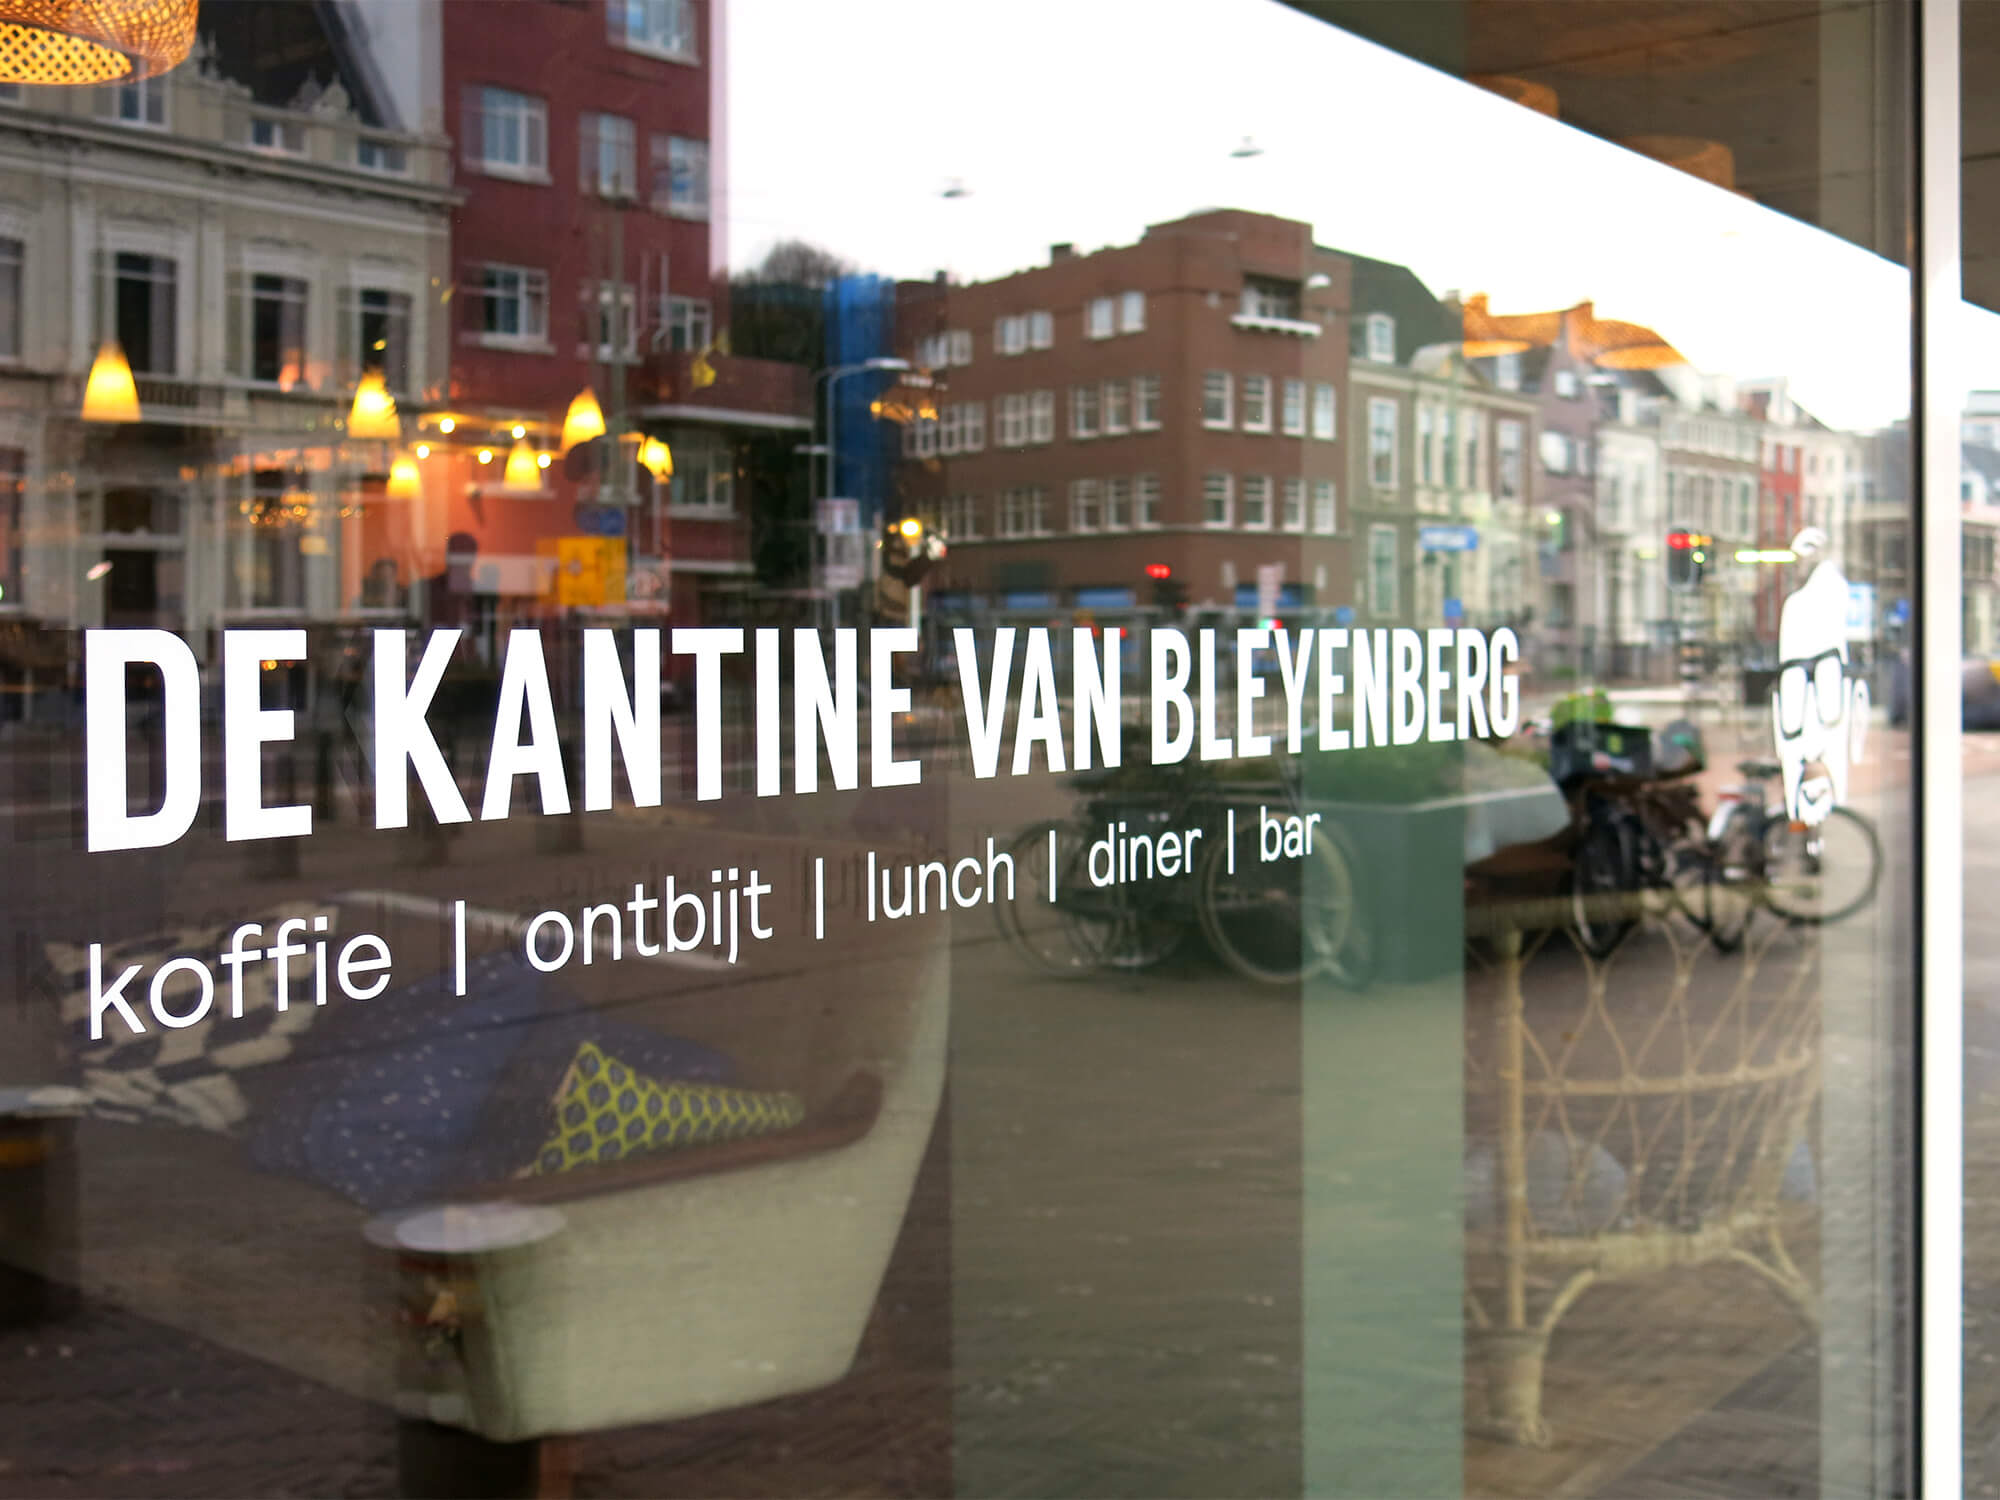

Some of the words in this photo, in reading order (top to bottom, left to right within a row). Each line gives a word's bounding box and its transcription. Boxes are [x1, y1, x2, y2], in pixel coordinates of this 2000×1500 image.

[85, 628, 313, 853] DE
[374, 627, 922, 831] KANTINE
[953, 626, 1122, 780] VAN
[1151, 626, 1521, 766] BLEYENBERG
[88, 914, 393, 1041] koffie
[525, 866, 774, 973] ontbijt
[867, 836, 1016, 923] lunch
[1088, 822, 1204, 888] diner
[1260, 804, 1322, 864] bar
